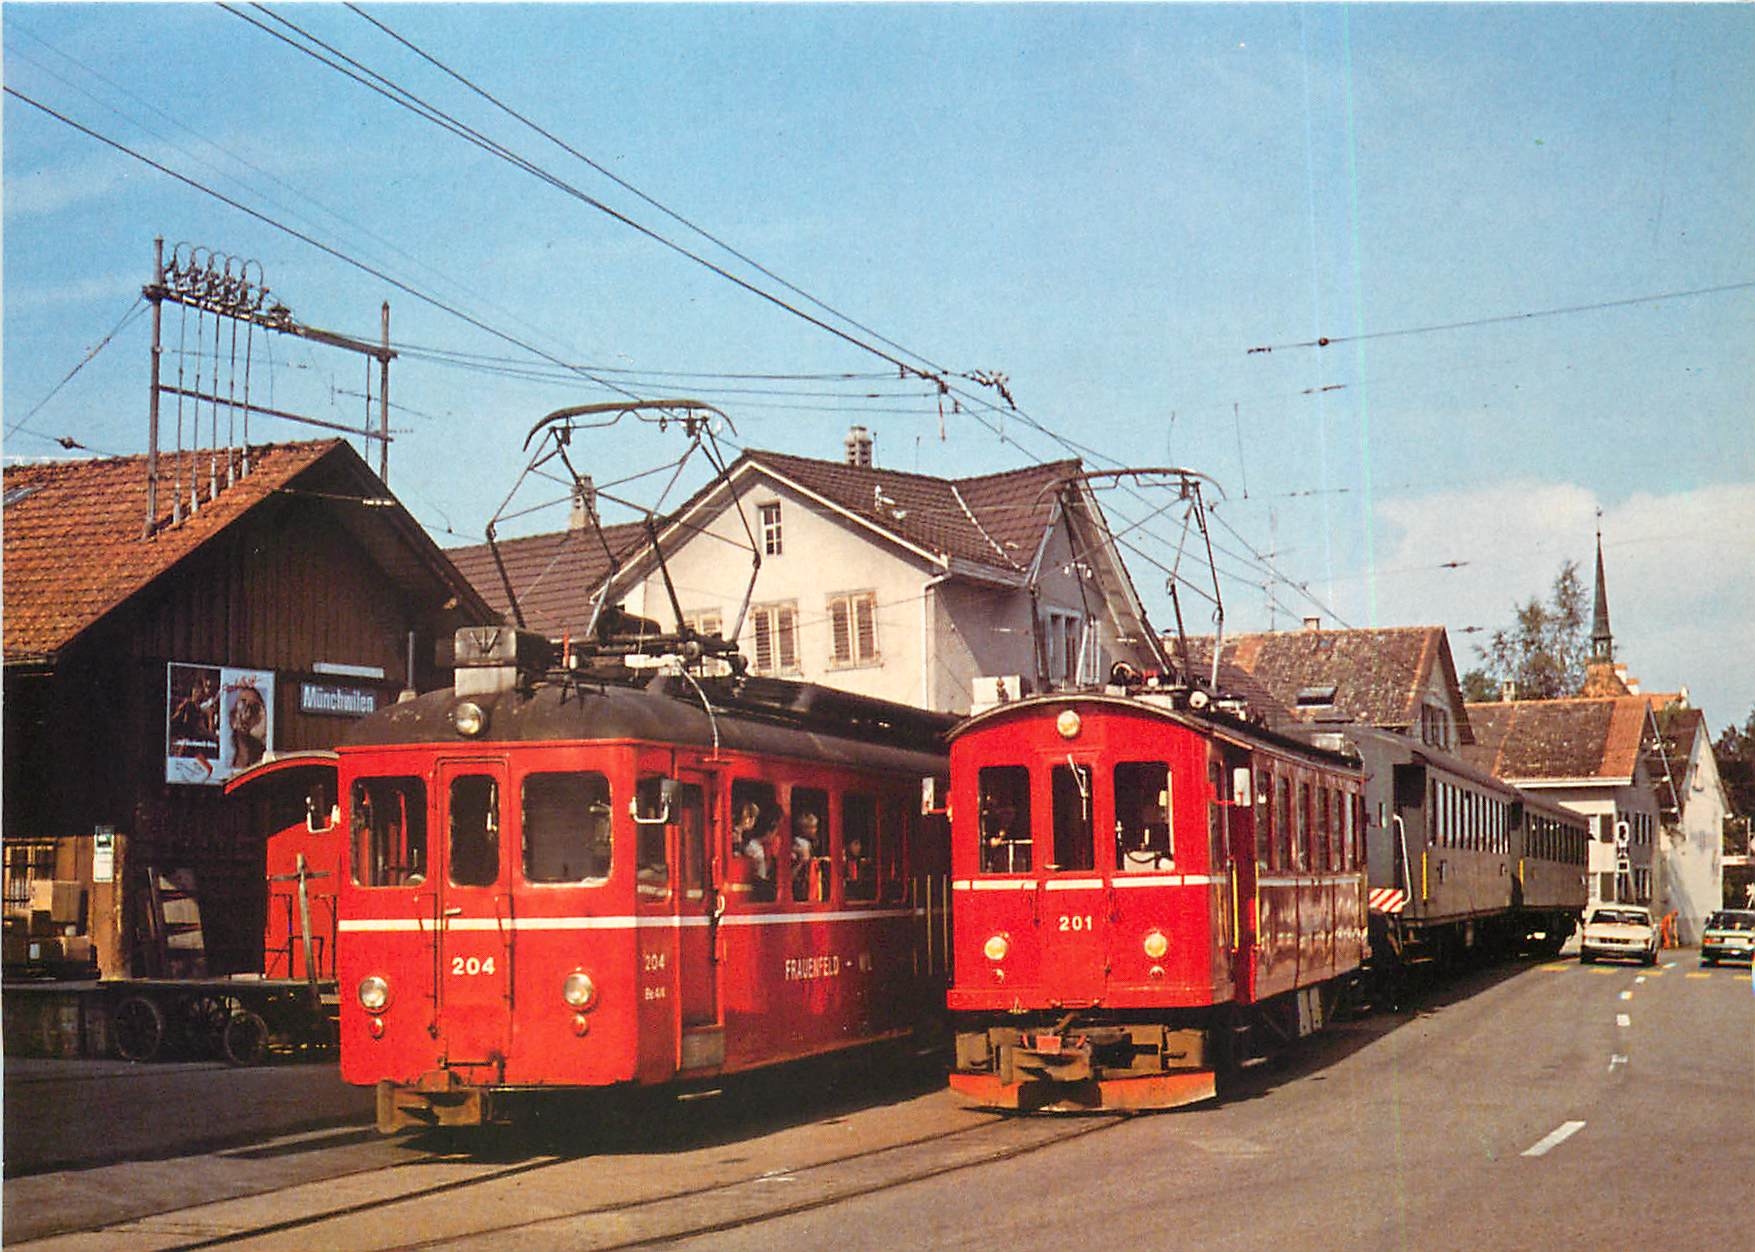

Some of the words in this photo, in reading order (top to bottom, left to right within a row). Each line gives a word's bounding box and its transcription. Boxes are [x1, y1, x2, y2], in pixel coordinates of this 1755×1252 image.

[303, 685, 374, 713] Münchwilen
[1058, 915, 1093, 931] 201
[451, 956, 496, 976] 204
[643, 953, 666, 971] 204
[784, 955, 840, 981] FRAUENFELD
